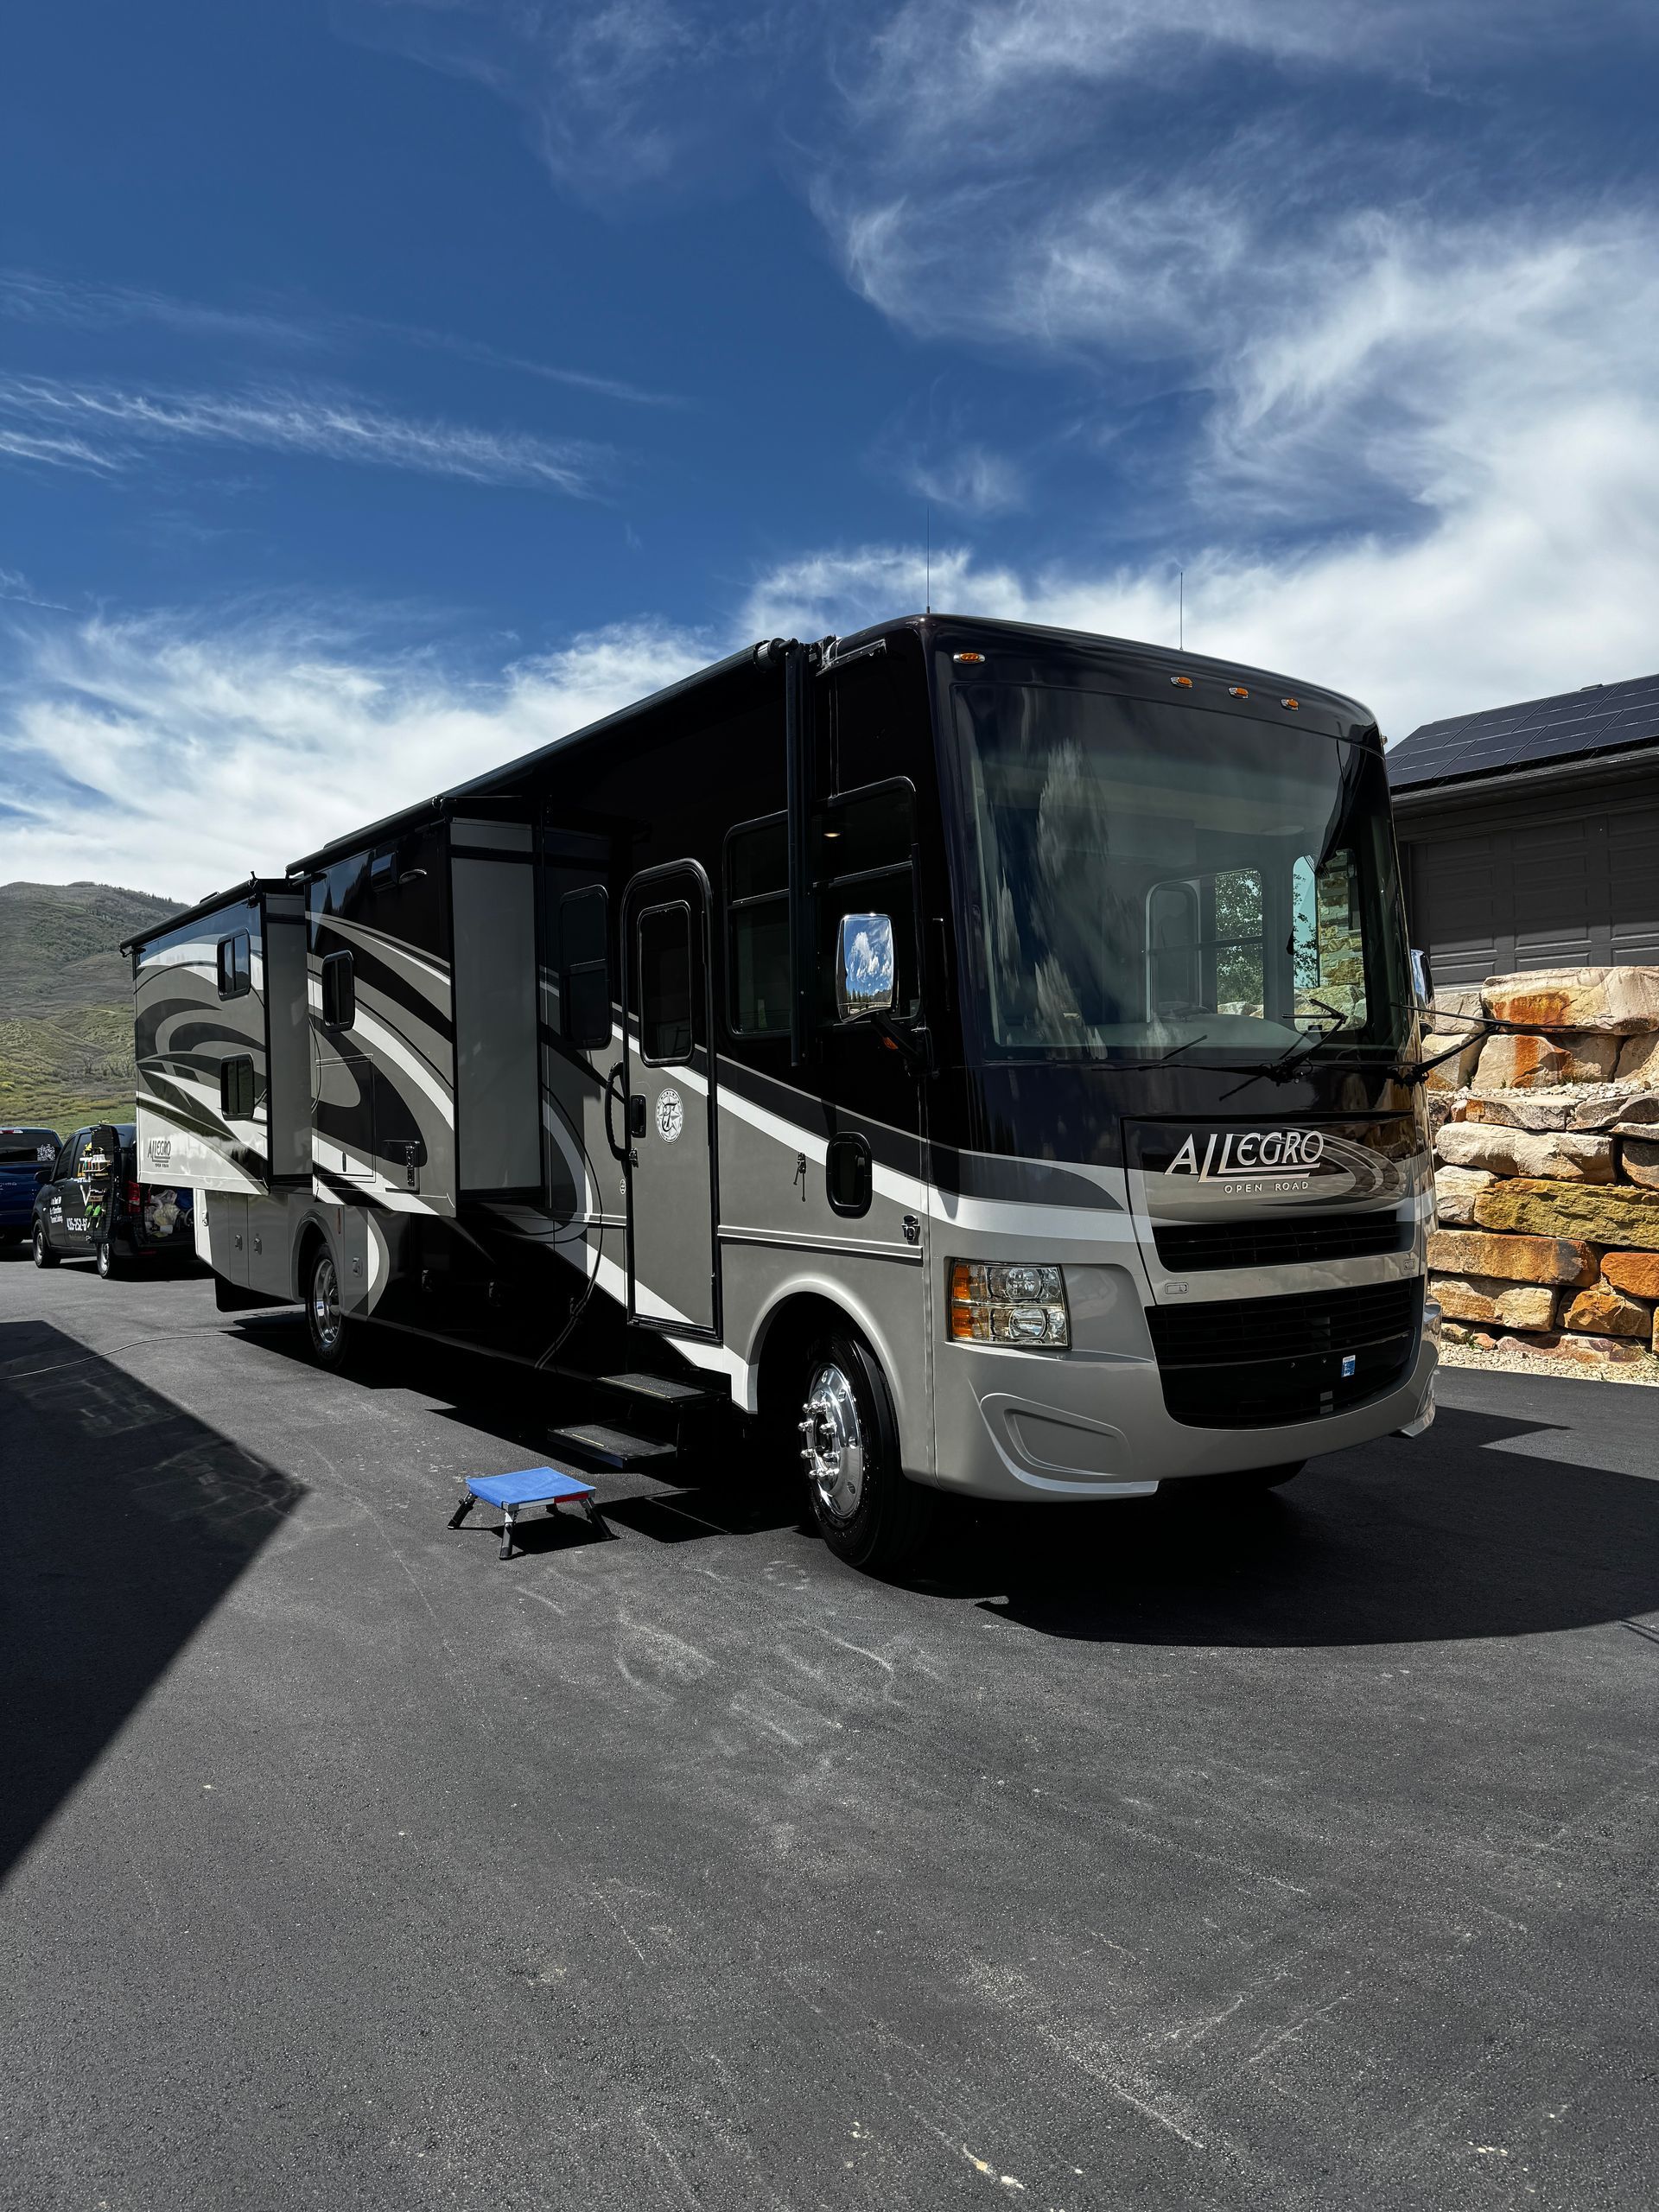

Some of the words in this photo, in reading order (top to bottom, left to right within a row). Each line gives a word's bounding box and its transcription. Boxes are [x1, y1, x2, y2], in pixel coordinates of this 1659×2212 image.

[148, 1140, 171, 1163] ALLEGRO
[1164, 1130, 1325, 1183] ALLEGRO
[1224, 1184, 1262, 1194] OPEN
[1274, 1181, 1309, 1192] ROAD
